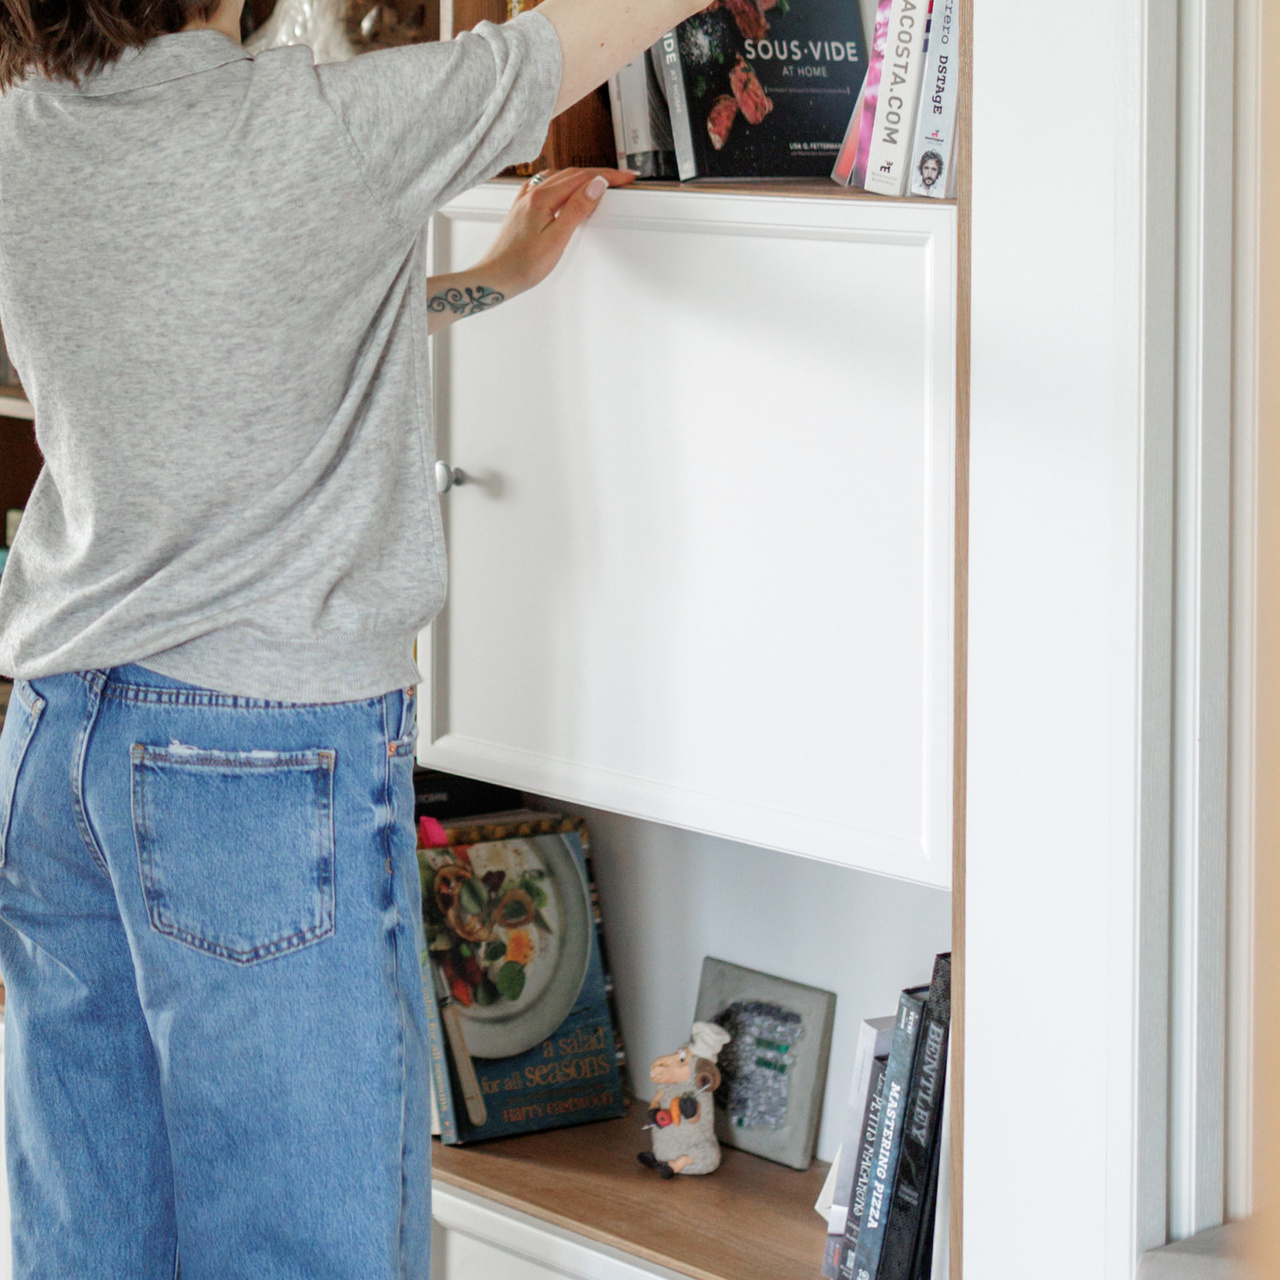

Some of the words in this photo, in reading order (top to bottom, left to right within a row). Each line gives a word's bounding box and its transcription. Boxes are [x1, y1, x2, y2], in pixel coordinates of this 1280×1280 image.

[782, 66, 794, 76] AT
[798, 66, 828, 77] HOME
[671, 83, 682, 114] HOME
[542, 1040, 554, 1057] a
[558, 1026, 605, 1054] salad
[481, 1075, 501, 1094] for
[504, 1072, 523, 1091] all
[523, 1056, 610, 1087] seasons
[911, 1022, 944, 1146] BENTLEY
[875, 1082, 901, 1179] MASTERING
[867, 1180, 886, 1228] PIZZA
